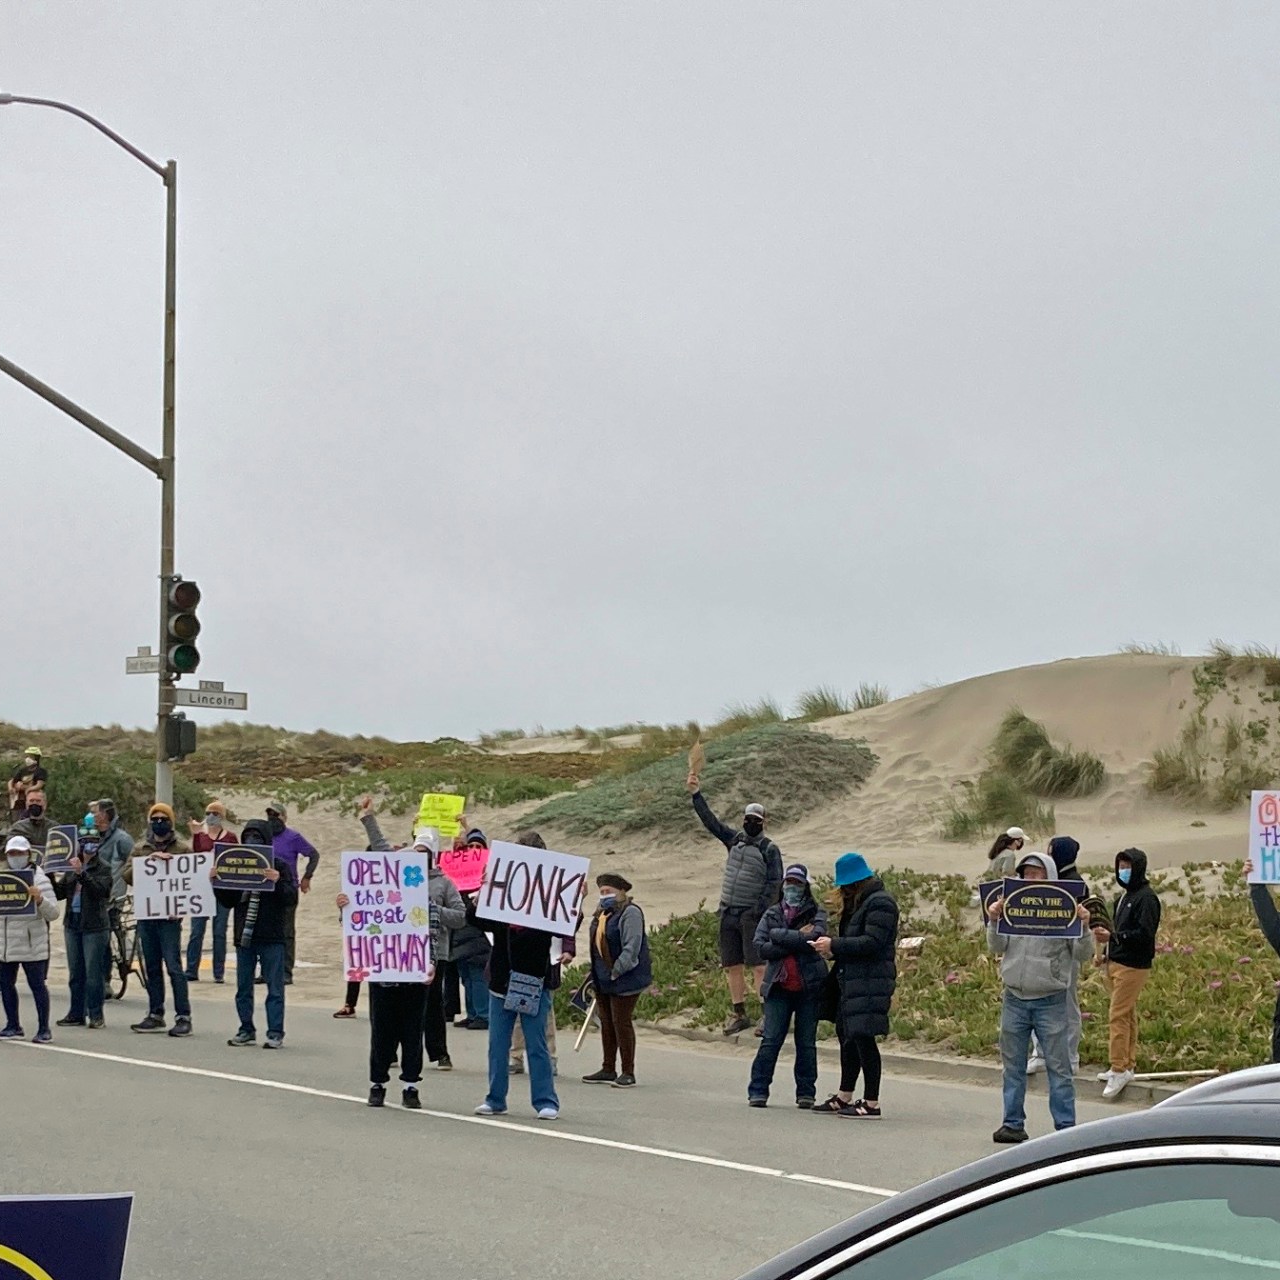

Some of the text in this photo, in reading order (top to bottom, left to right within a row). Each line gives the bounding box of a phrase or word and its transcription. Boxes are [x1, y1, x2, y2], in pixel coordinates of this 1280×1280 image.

[189, 693, 235, 706] Lincoln
[144, 854, 207, 876] STOP
[348, 855, 401, 889] OPEN
[157, 878, 192, 892] THE
[486, 857, 586, 923] HONK!
[146, 895, 203, 917] LIES
[355, 889, 384, 906] the
[1020, 896, 1063, 907] OPEN THE
[351, 906, 407, 931] great
[1008, 908, 1073, 918] GREAT HIGHWAY
[347, 933, 431, 973] HIGHWAY
